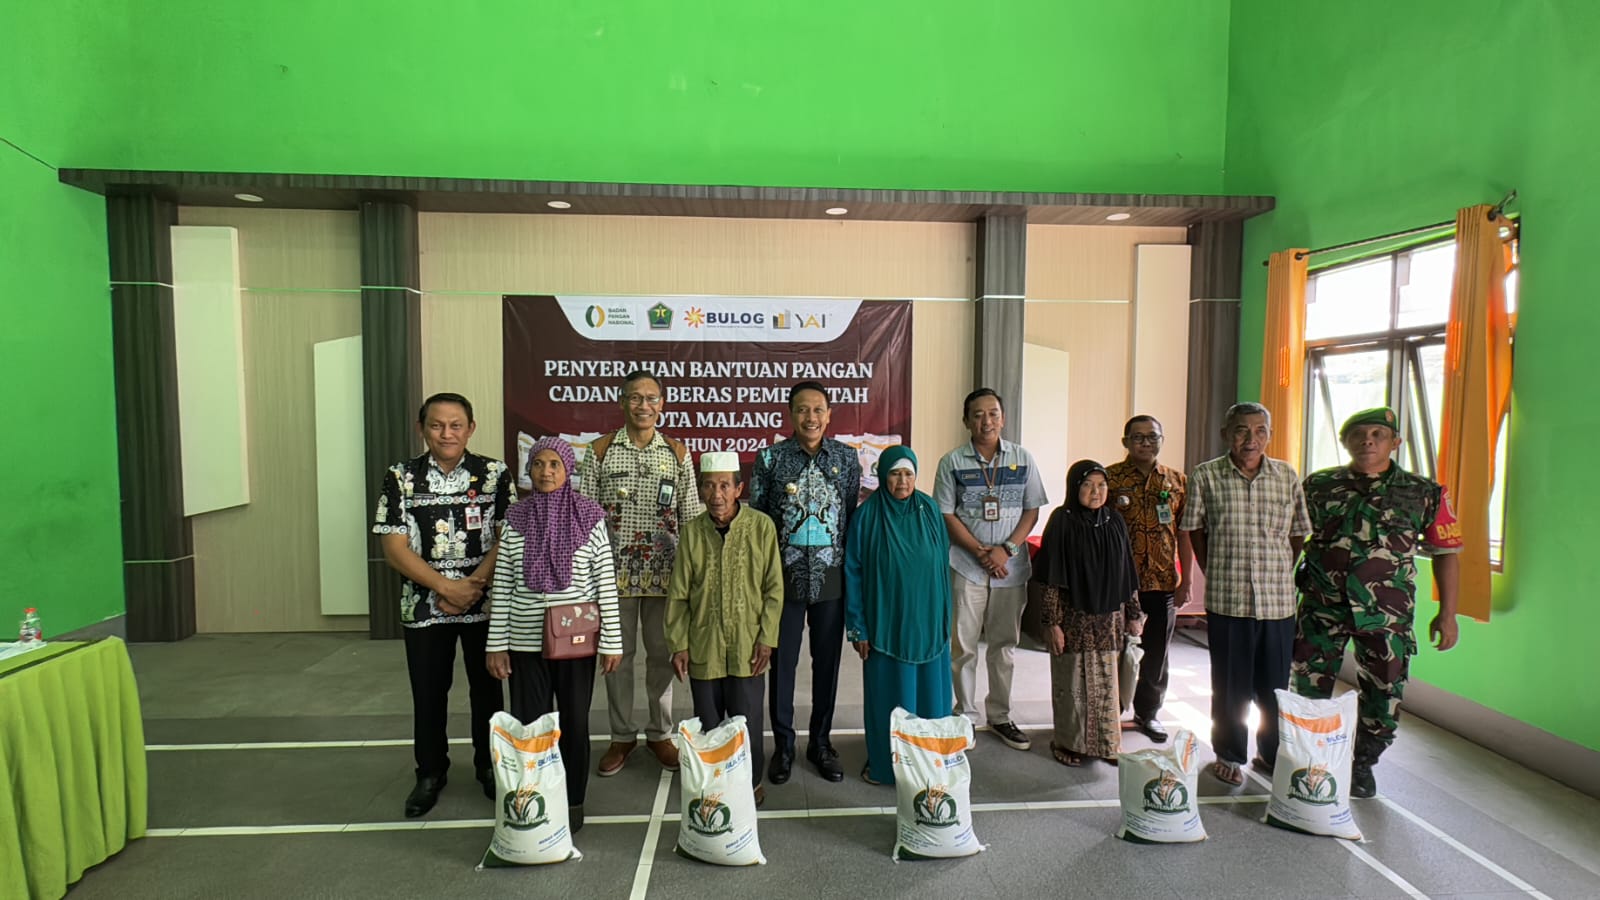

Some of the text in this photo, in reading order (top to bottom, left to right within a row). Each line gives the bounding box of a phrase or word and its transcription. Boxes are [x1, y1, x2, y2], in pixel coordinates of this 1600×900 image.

[706, 312, 765, 324] BULOG
[544, 360, 873, 379] PENYERAHAN BANTUAN PANGAN
[549, 385, 869, 404] CADAN BERAS PEMETAH
[655, 411, 783, 428] OTA MALANG
[725, 437, 770, 452] 2024
